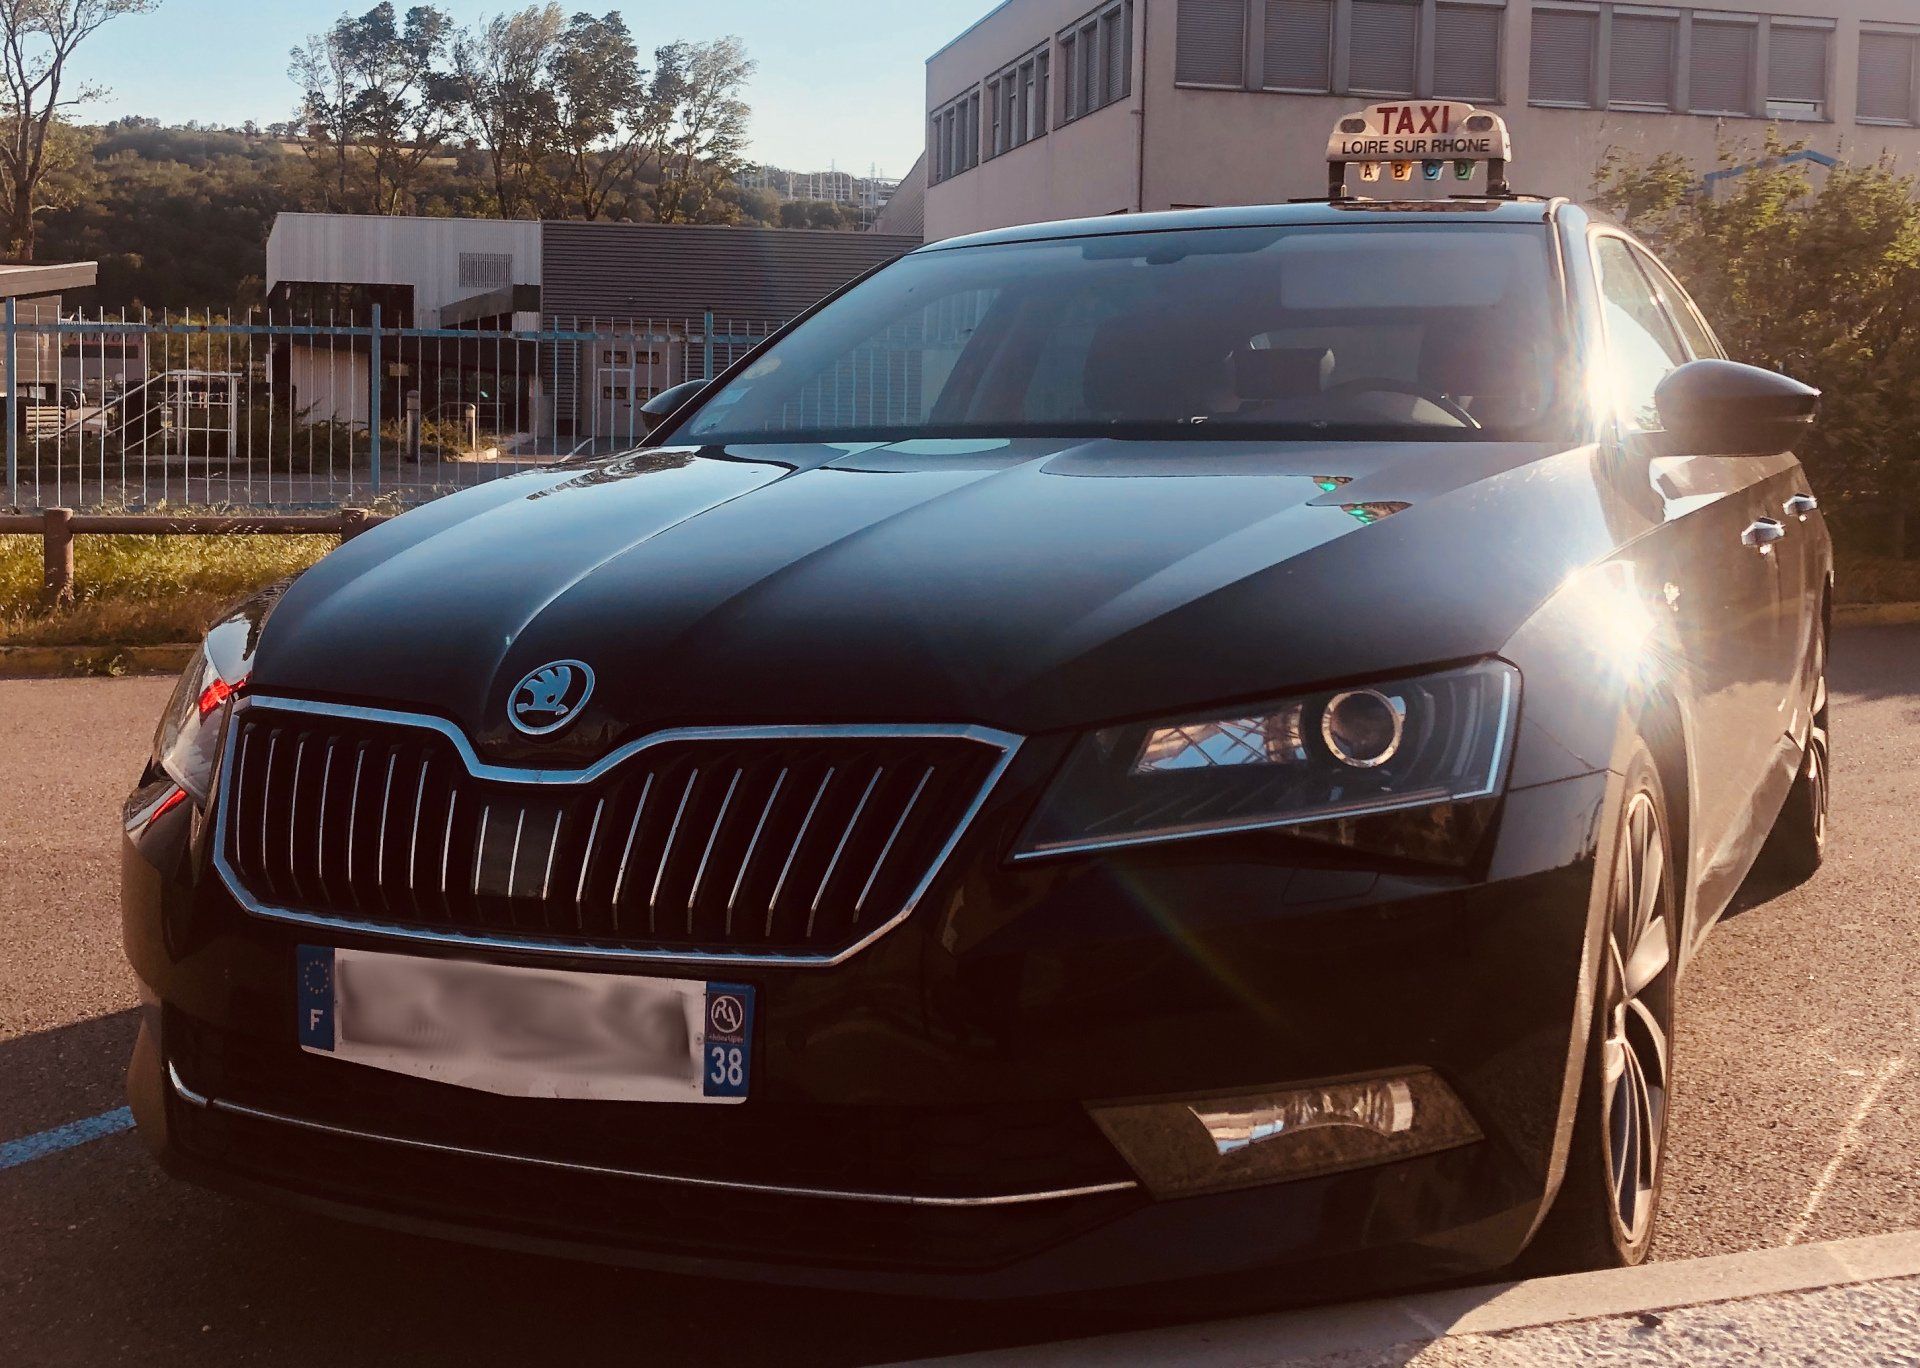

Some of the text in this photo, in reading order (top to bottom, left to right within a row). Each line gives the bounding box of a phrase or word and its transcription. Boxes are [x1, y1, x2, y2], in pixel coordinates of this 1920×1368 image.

[1376, 105, 1450, 135] TAXI
[1342, 138, 1490, 155] LOIRE SUR RHONE
[1363, 162, 1468, 178] A B C D
[310, 1008, 324, 1031] F
[711, 1046, 743, 1087] 38
